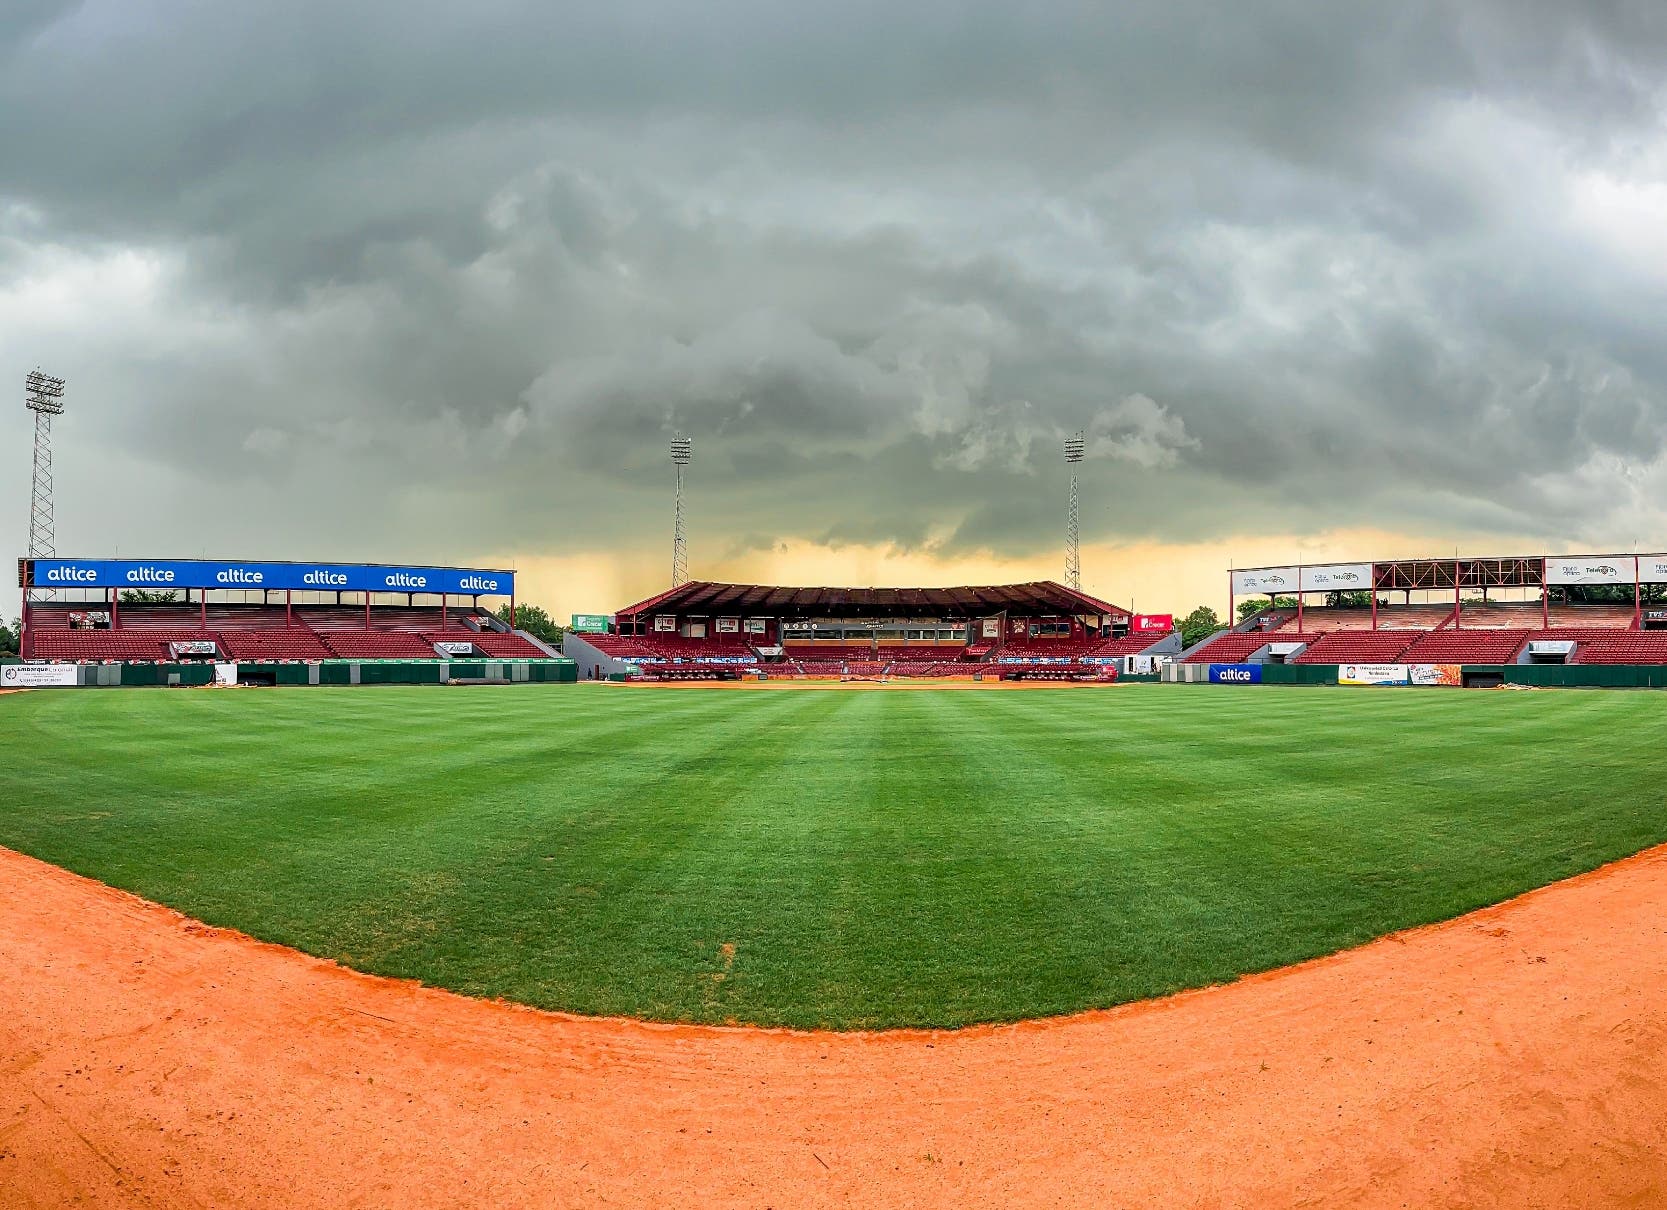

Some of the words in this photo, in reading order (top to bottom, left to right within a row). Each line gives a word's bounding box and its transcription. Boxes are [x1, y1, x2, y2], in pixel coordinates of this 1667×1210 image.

[47, 566, 97, 582] altice
[126, 567, 175, 582] altice
[216, 568, 264, 583] altice
[303, 571, 348, 585] altice
[385, 573, 427, 588] altice
[459, 576, 498, 591] altice
[1219, 668, 1251, 681] altice
